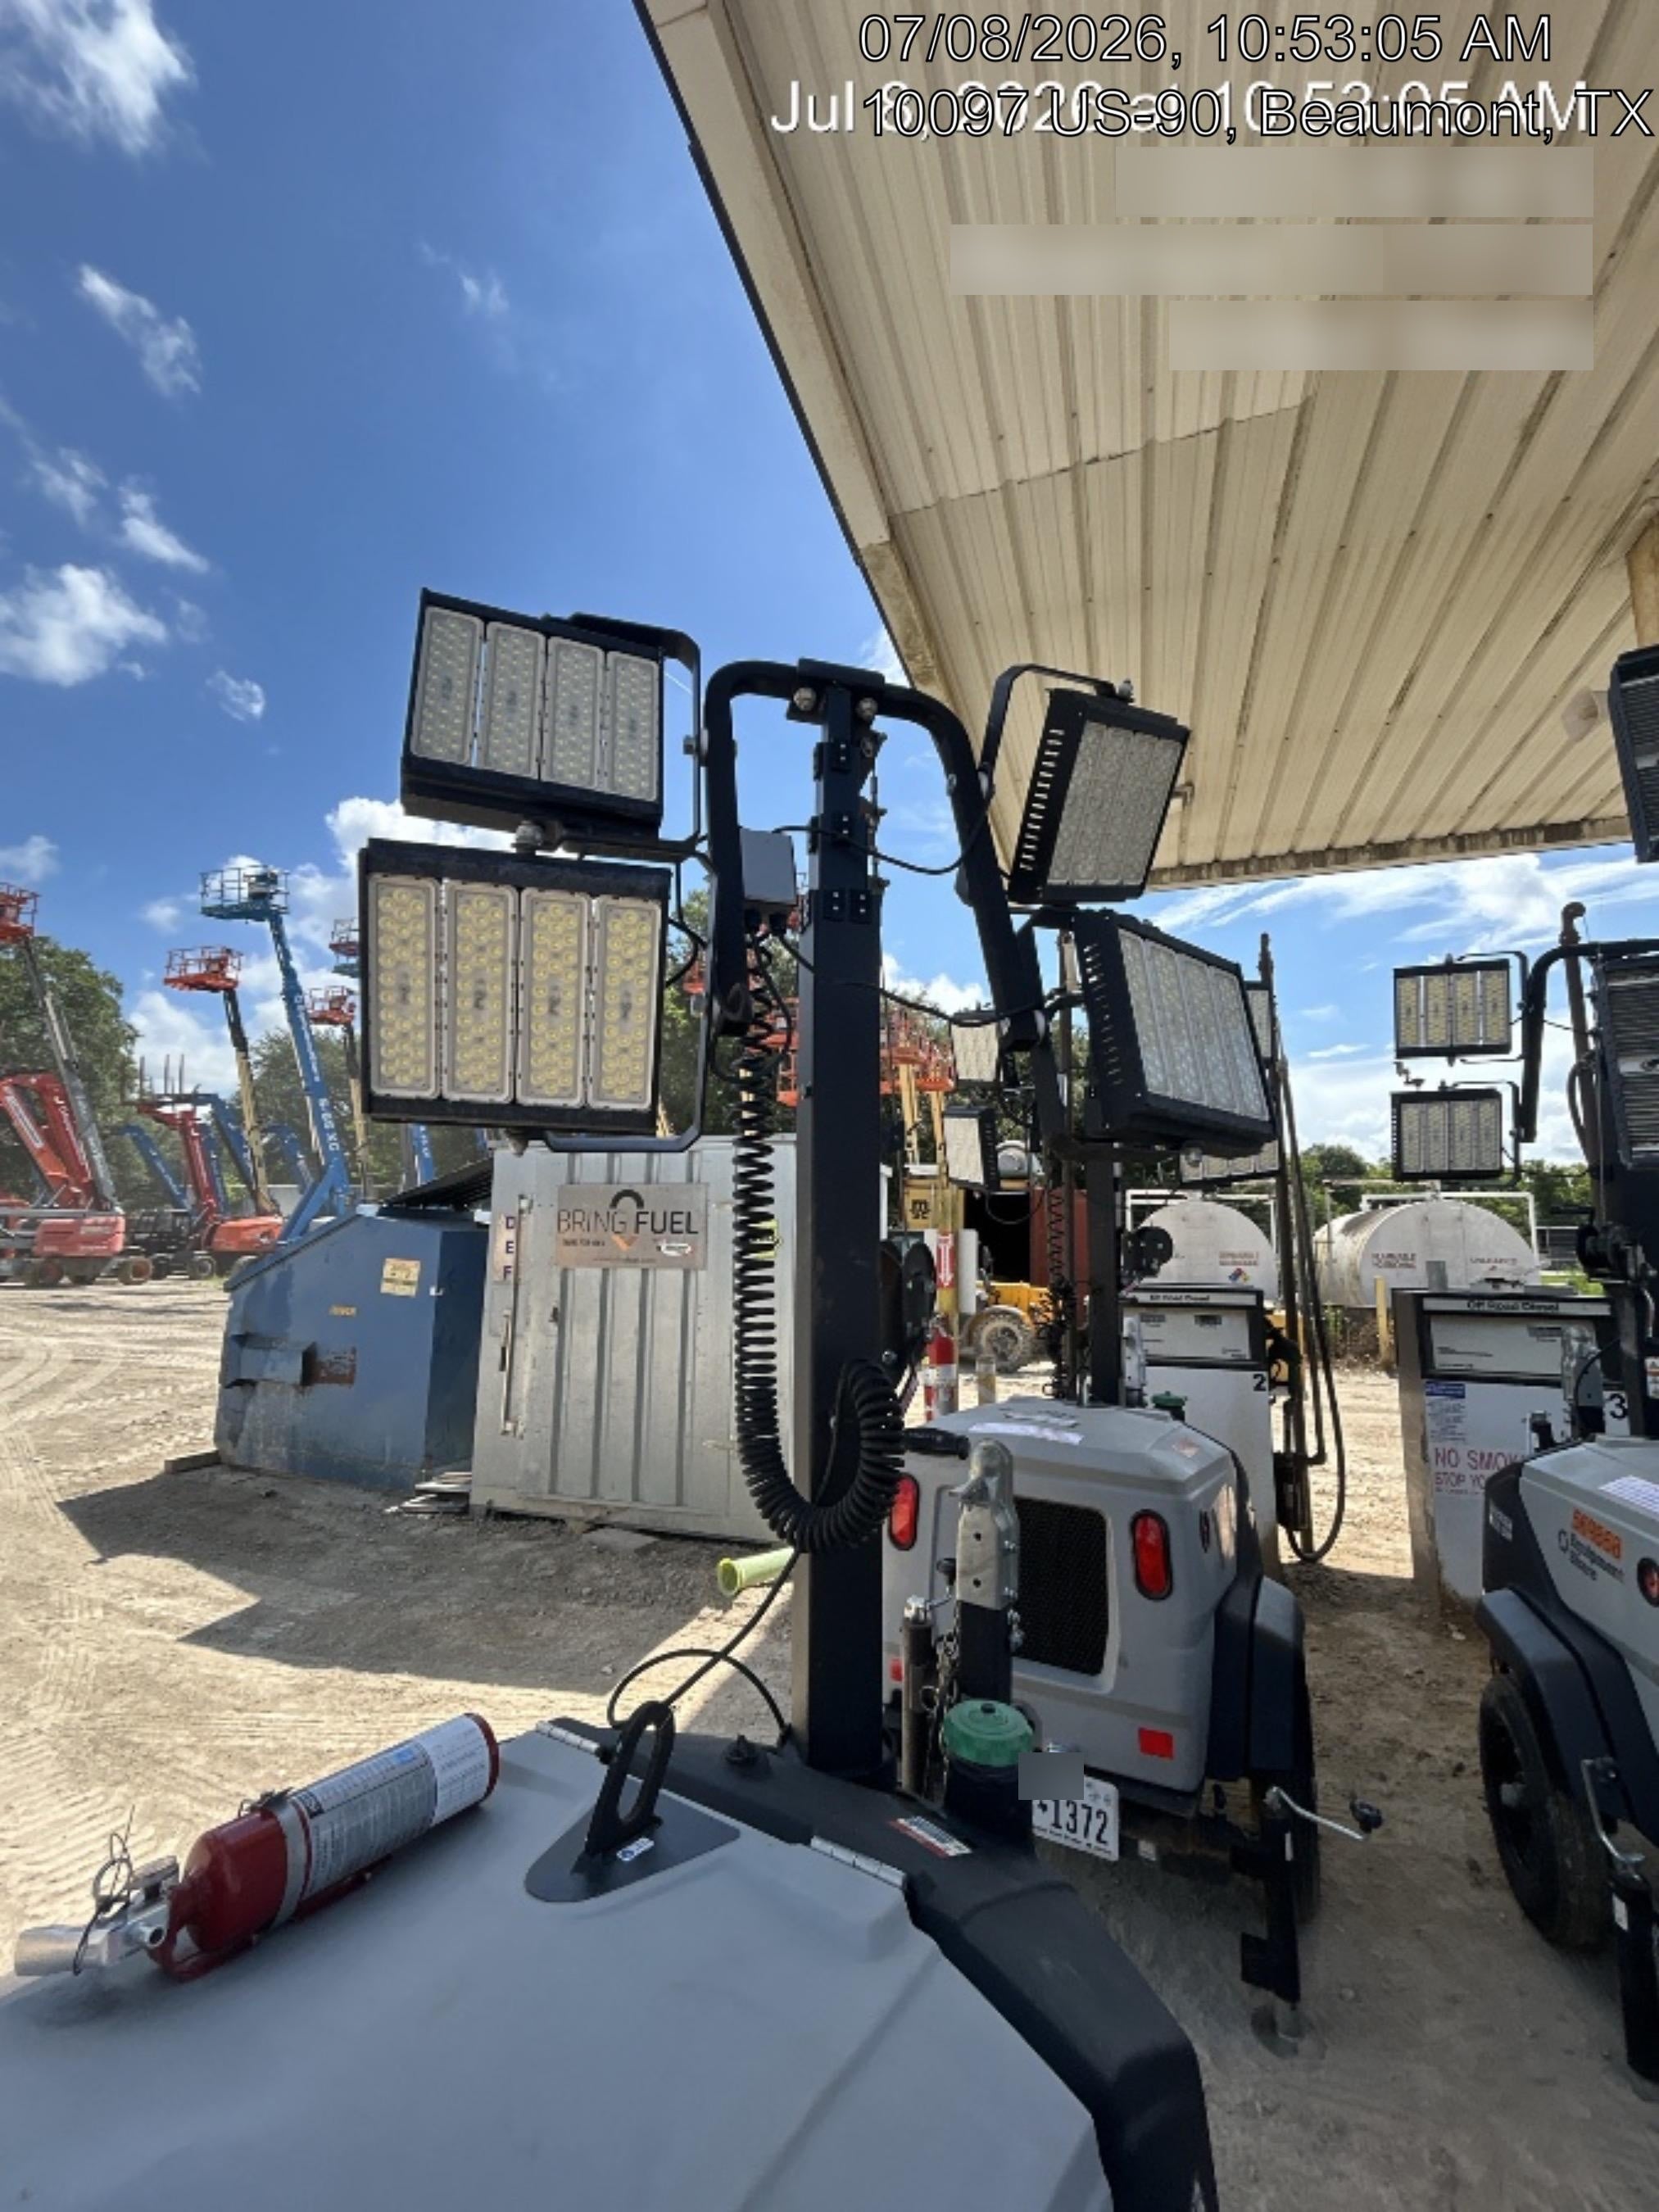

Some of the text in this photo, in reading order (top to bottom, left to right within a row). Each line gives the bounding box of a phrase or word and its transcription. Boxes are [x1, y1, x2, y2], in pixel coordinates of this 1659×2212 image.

[636, 1210, 699, 1234] FUEL
[1253, 1373, 1267, 1391] 2
[1608, 1393, 1628, 1419] 3
[1435, 1448, 1525, 1471] NO SMOK
[1051, 1799, 1108, 1845] 1372
